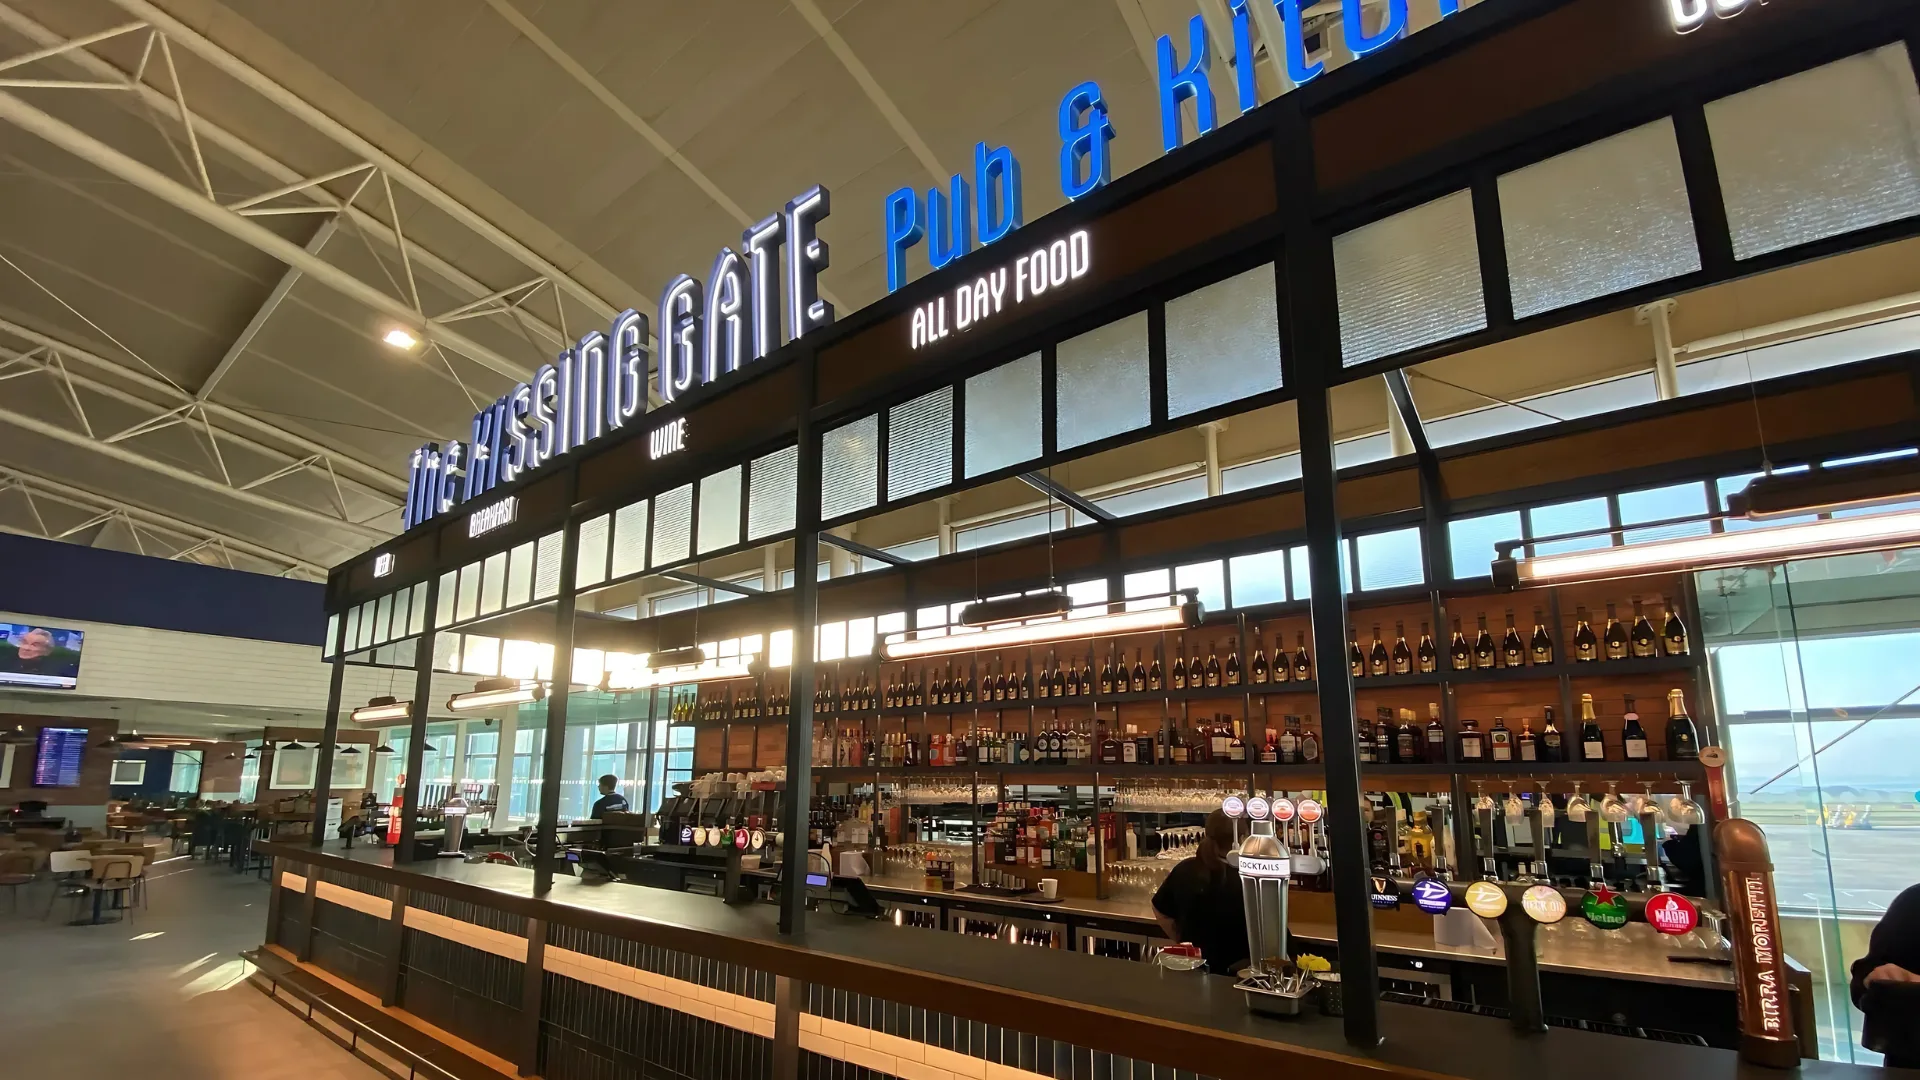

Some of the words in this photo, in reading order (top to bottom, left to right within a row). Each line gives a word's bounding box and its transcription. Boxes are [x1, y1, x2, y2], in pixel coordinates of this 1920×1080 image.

[885, 142, 1023, 293] Pub
[1059, 81, 1116, 201] &
[657, 184, 835, 402] GATE
[911, 306, 949, 350] ALL
[955, 267, 1006, 330] DAY
[1015, 230, 1090, 303] FOOD
[650, 417, 686, 460] WINE
[468, 496, 519, 538] BREAKFAST
[1239, 860, 1280, 872] COCKTAILS
[1744, 874, 1773, 964] MORETTI
[1757, 970, 1781, 1032] BIRRA
